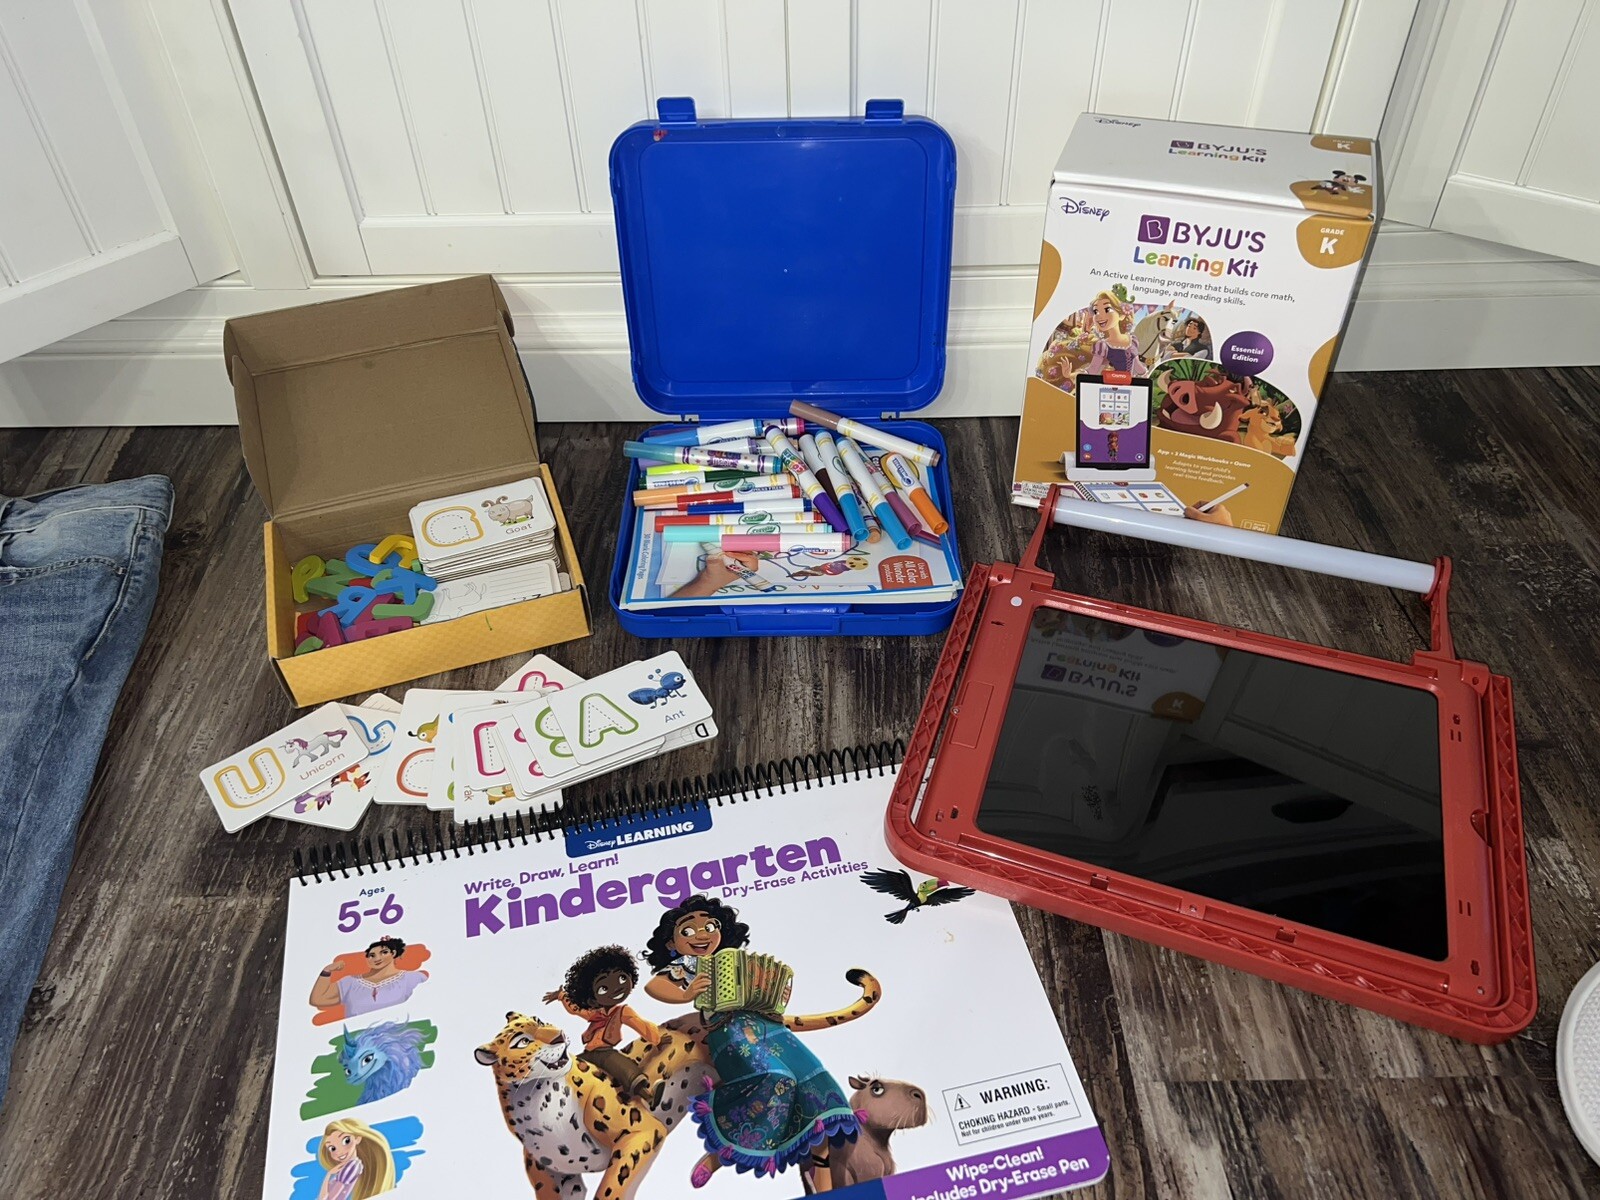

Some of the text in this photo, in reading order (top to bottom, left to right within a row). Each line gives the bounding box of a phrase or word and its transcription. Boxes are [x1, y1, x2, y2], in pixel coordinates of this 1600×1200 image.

[1168, 148, 1265, 163] Learning Kit
[1197, 143, 1267, 156] BYJU'S
[1059, 196, 1110, 221] Disney
[1172, 221, 1266, 252] BYJU'S
[1320, 227, 1345, 236] GRADE
[1320, 237, 1339, 254] K
[1133, 246, 1259, 278] Learning Kit
[1090, 268, 1296, 303] An Active Learning program that builds core math,
[1132, 284, 1247, 307] language, and reading skills.
[1231, 345, 1265, 355] Essential
[1232, 353, 1259, 363] Edition
[505, 523, 533, 535] Goat
[893, 561, 906, 583] Wonder
[904, 560, 919, 583] All Color
[664, 710, 684, 723] Ant
[299, 752, 346, 780] Unicorn
[585, 820, 695, 850] Disney LEARNING
[464, 853, 619, 895] Write, Draw, Learn!
[465, 836, 841, 938] Kindergarten
[722, 861, 869, 898] Dry-Erase Activities
[359, 886, 385, 897] Ages
[338, 893, 404, 933] 5-6
[979, 1078, 1050, 1104] WARNING:
[958, 1100, 1071, 1130] CHOKING HAZARD Small parts.
[961, 1130, 972, 1138] Not
[981, 1122, 1005, 1133] children
[1006, 1118, 1021, 1128] under
[1022, 1114, 1037, 1124] three
[1038, 1111, 1056, 1121] years.
[946, 1146, 1044, 1182] Wipe-Clean!
[978, 1165, 1057, 1194] Dry-Erase
[1058, 1158, 1090, 1174] Pen
